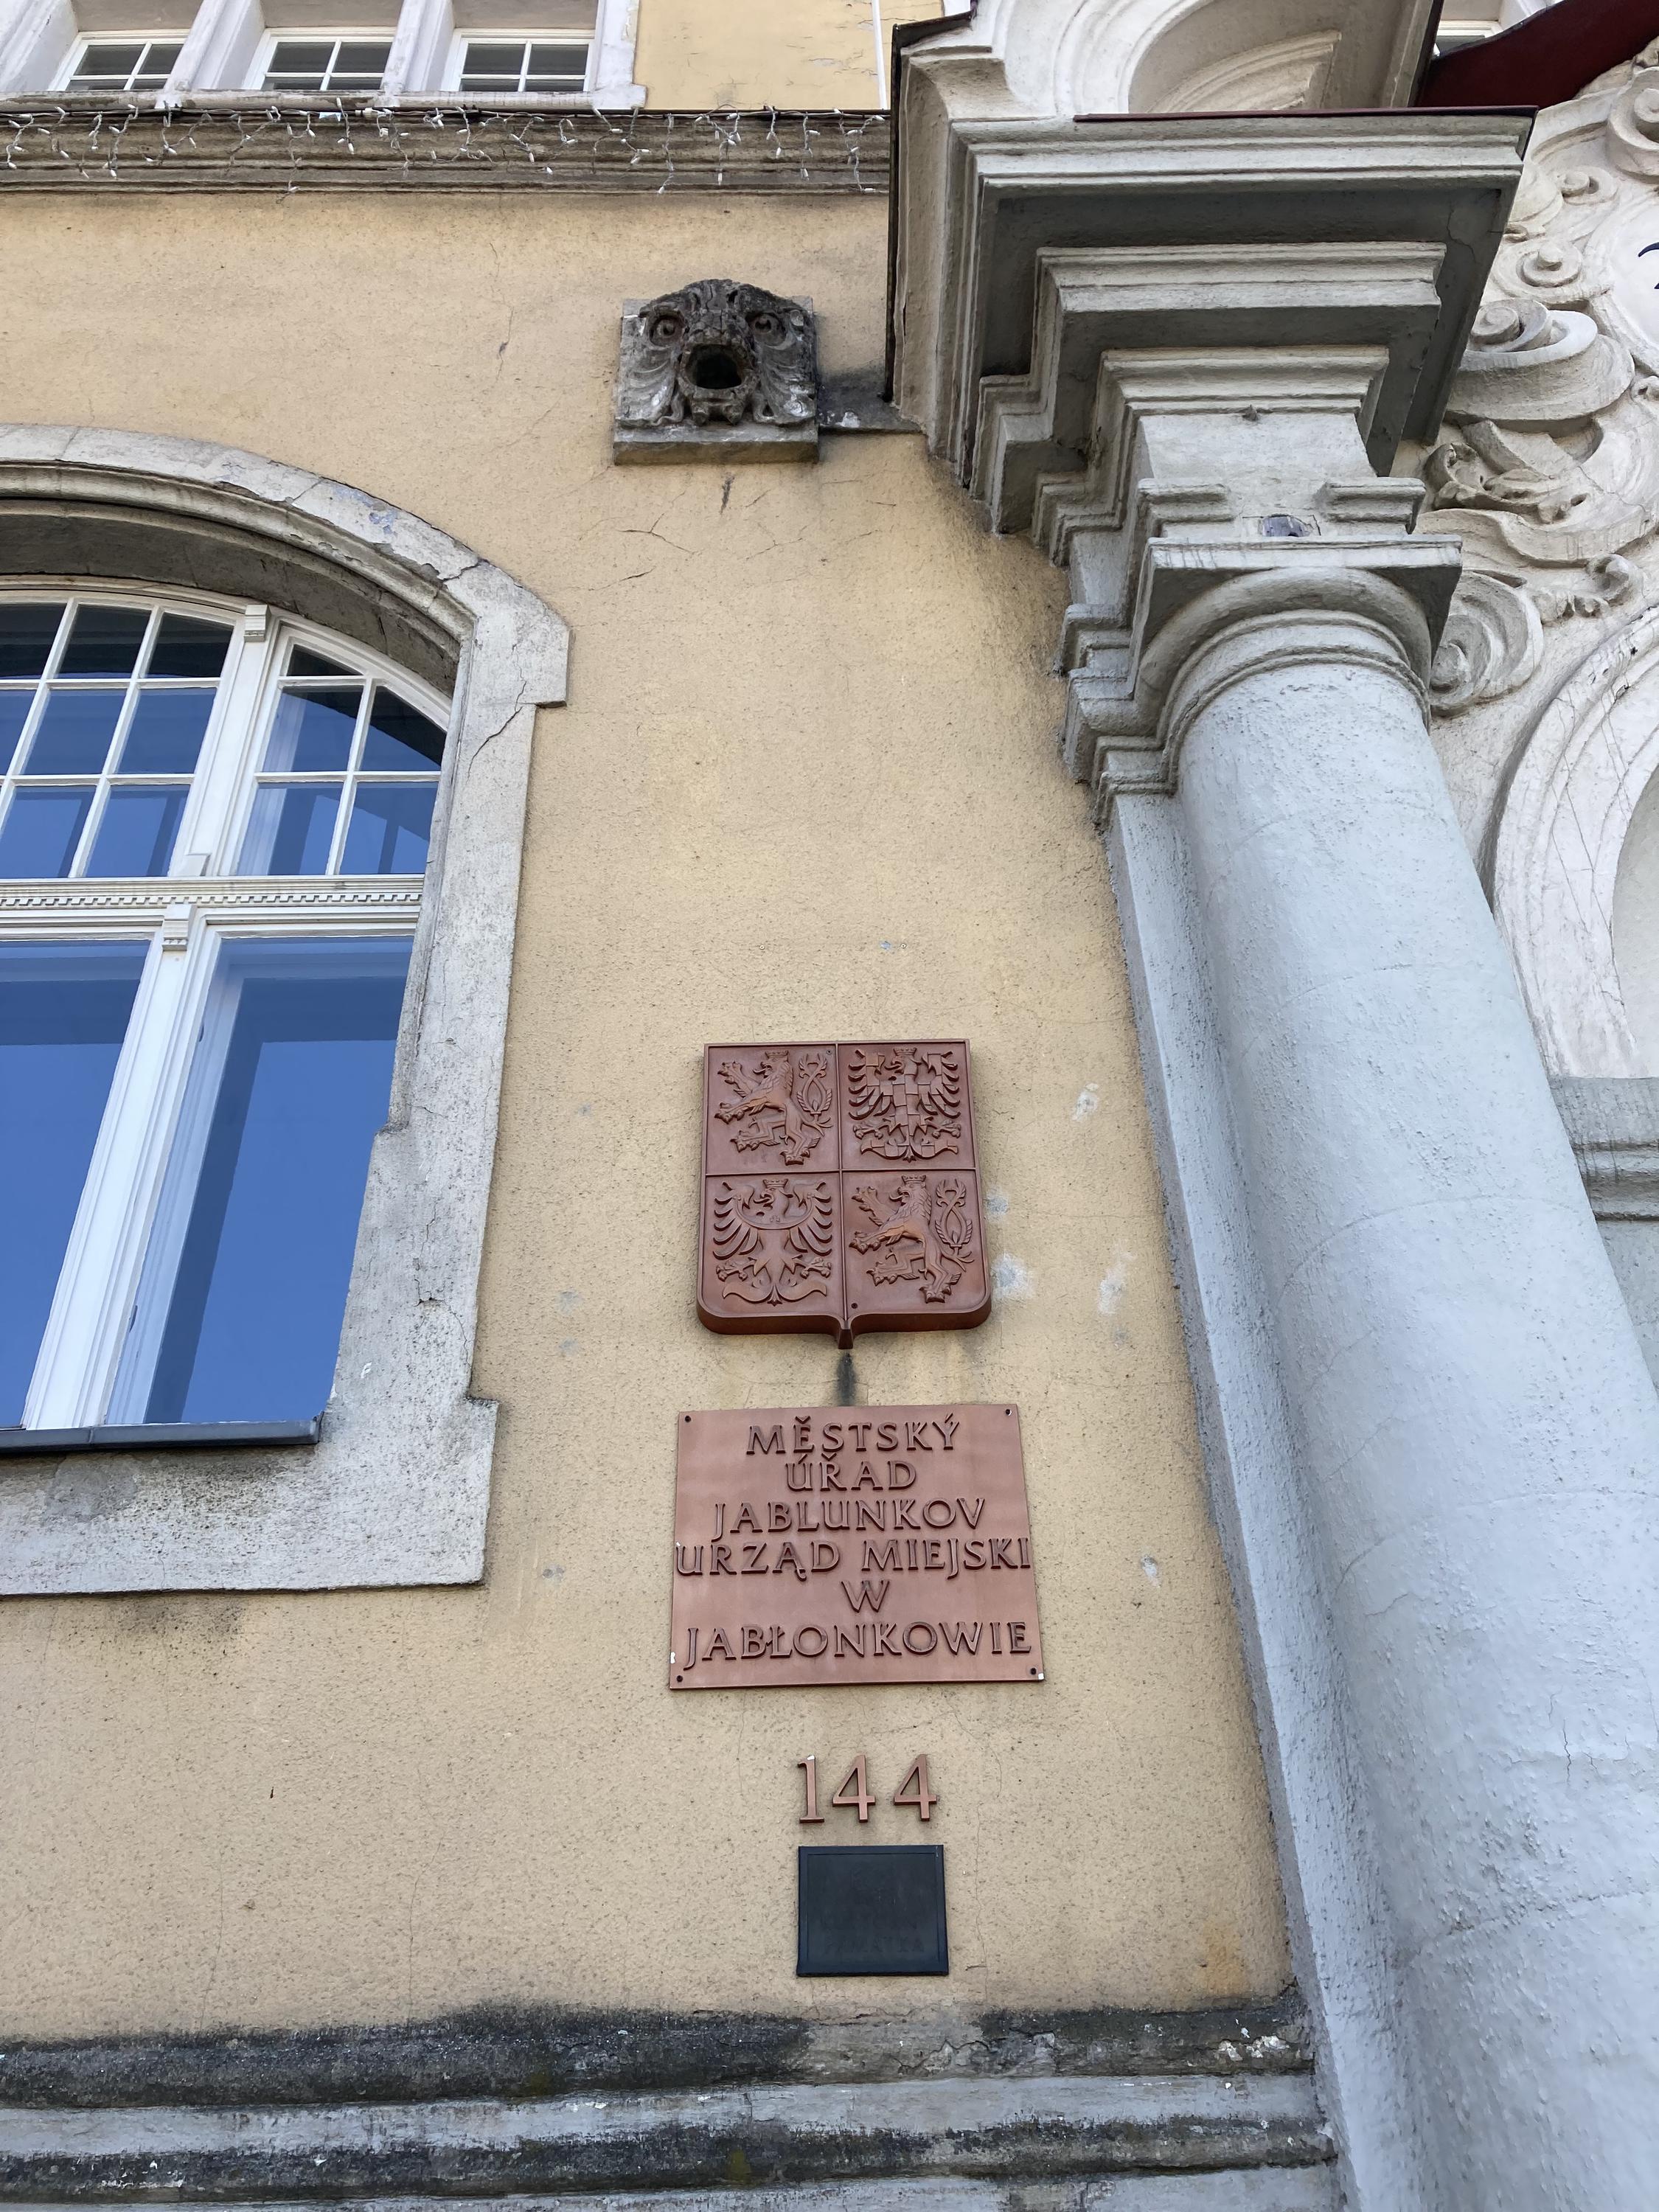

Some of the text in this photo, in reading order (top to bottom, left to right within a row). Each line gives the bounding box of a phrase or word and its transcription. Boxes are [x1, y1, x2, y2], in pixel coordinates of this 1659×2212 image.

[746, 1413, 959, 1455] MĚSTSKÝ
[786, 1453, 917, 1491] ÚŘAD
[712, 1498, 985, 1542] JABLUNKOV
[675, 1537, 1032, 1581] URZĄD MIEJSKI
[841, 1580, 890, 1613] W
[683, 1621, 1032, 1671] JABŁONKOWIE
[797, 1753, 938, 1823] 144
